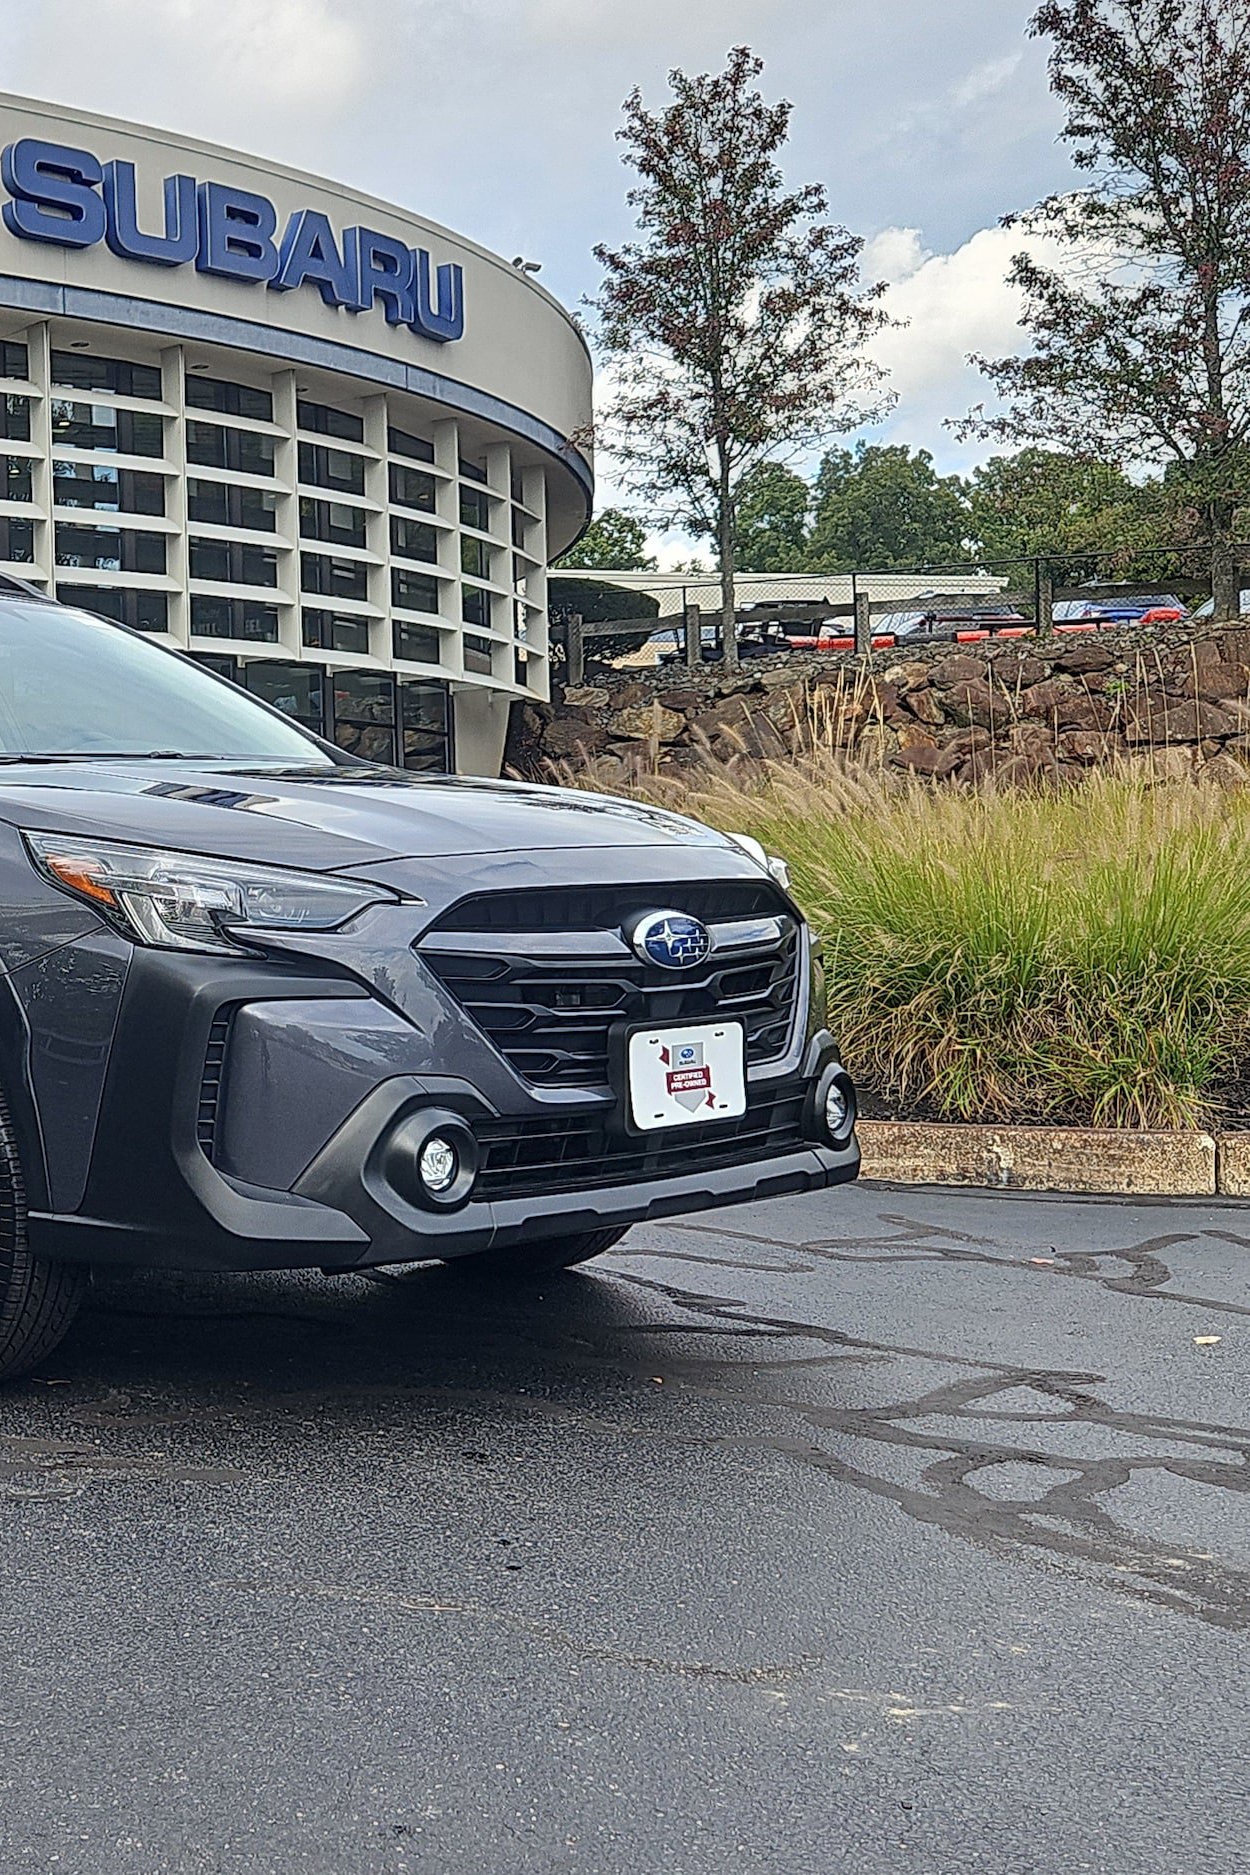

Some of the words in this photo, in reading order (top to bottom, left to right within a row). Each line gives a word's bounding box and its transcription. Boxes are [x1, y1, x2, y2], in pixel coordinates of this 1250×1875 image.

[0, 137, 464, 344] SUBARU
[673, 1071, 703, 1081] CERTIFIED
[670, 1079, 707, 1089] PRE-OWNED
